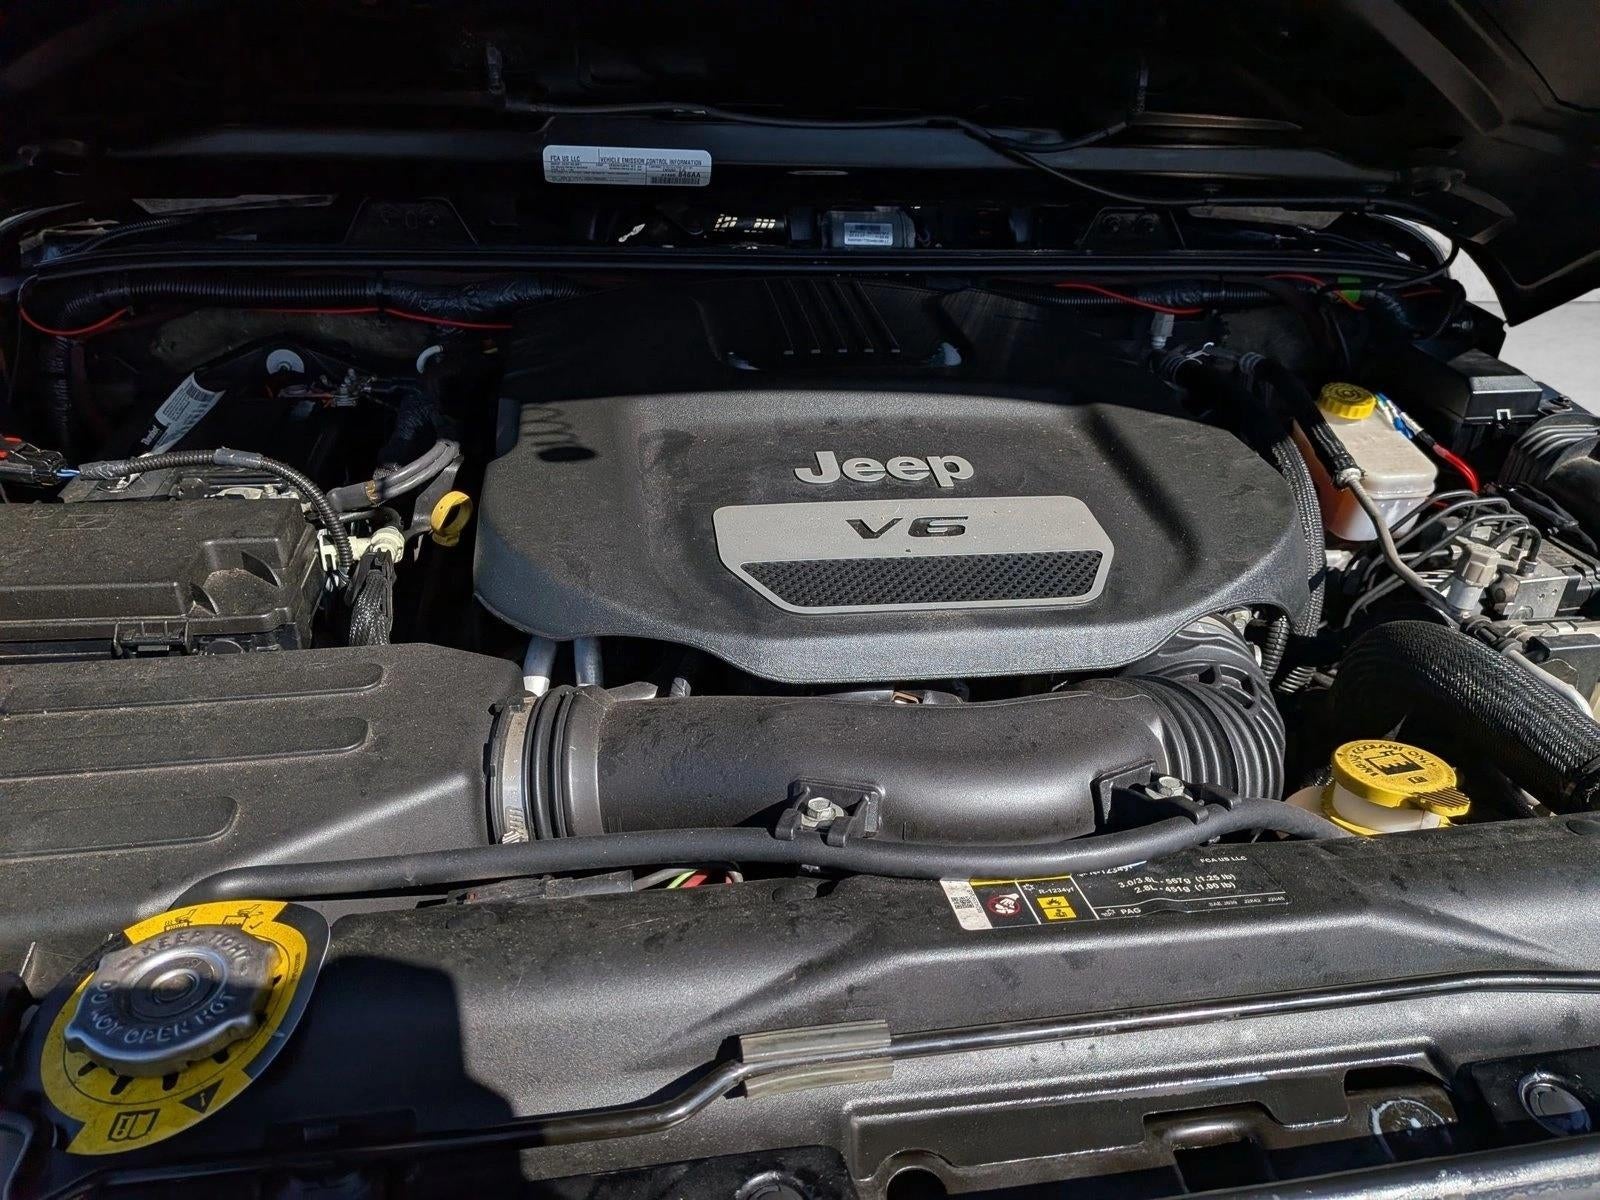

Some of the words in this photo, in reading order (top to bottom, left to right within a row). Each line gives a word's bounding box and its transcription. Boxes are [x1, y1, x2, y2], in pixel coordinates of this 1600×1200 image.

[600, 157, 620, 165] VEHICLE
[646, 158, 668, 166] CONTROL
[793, 450, 974, 489] Jeep
[846, 516, 969, 540] V6
[1195, 875, 1220, 883] (1.25
[1221, 873, 1236, 881] lb)
[1038, 886, 1074, 894] R-1234yf
[1220, 881, 1236, 889] lb)
[1120, 907, 1141, 915] PAG
[141, 930, 202, 955] KEEP
[124, 1022, 191, 1044] OPEN
